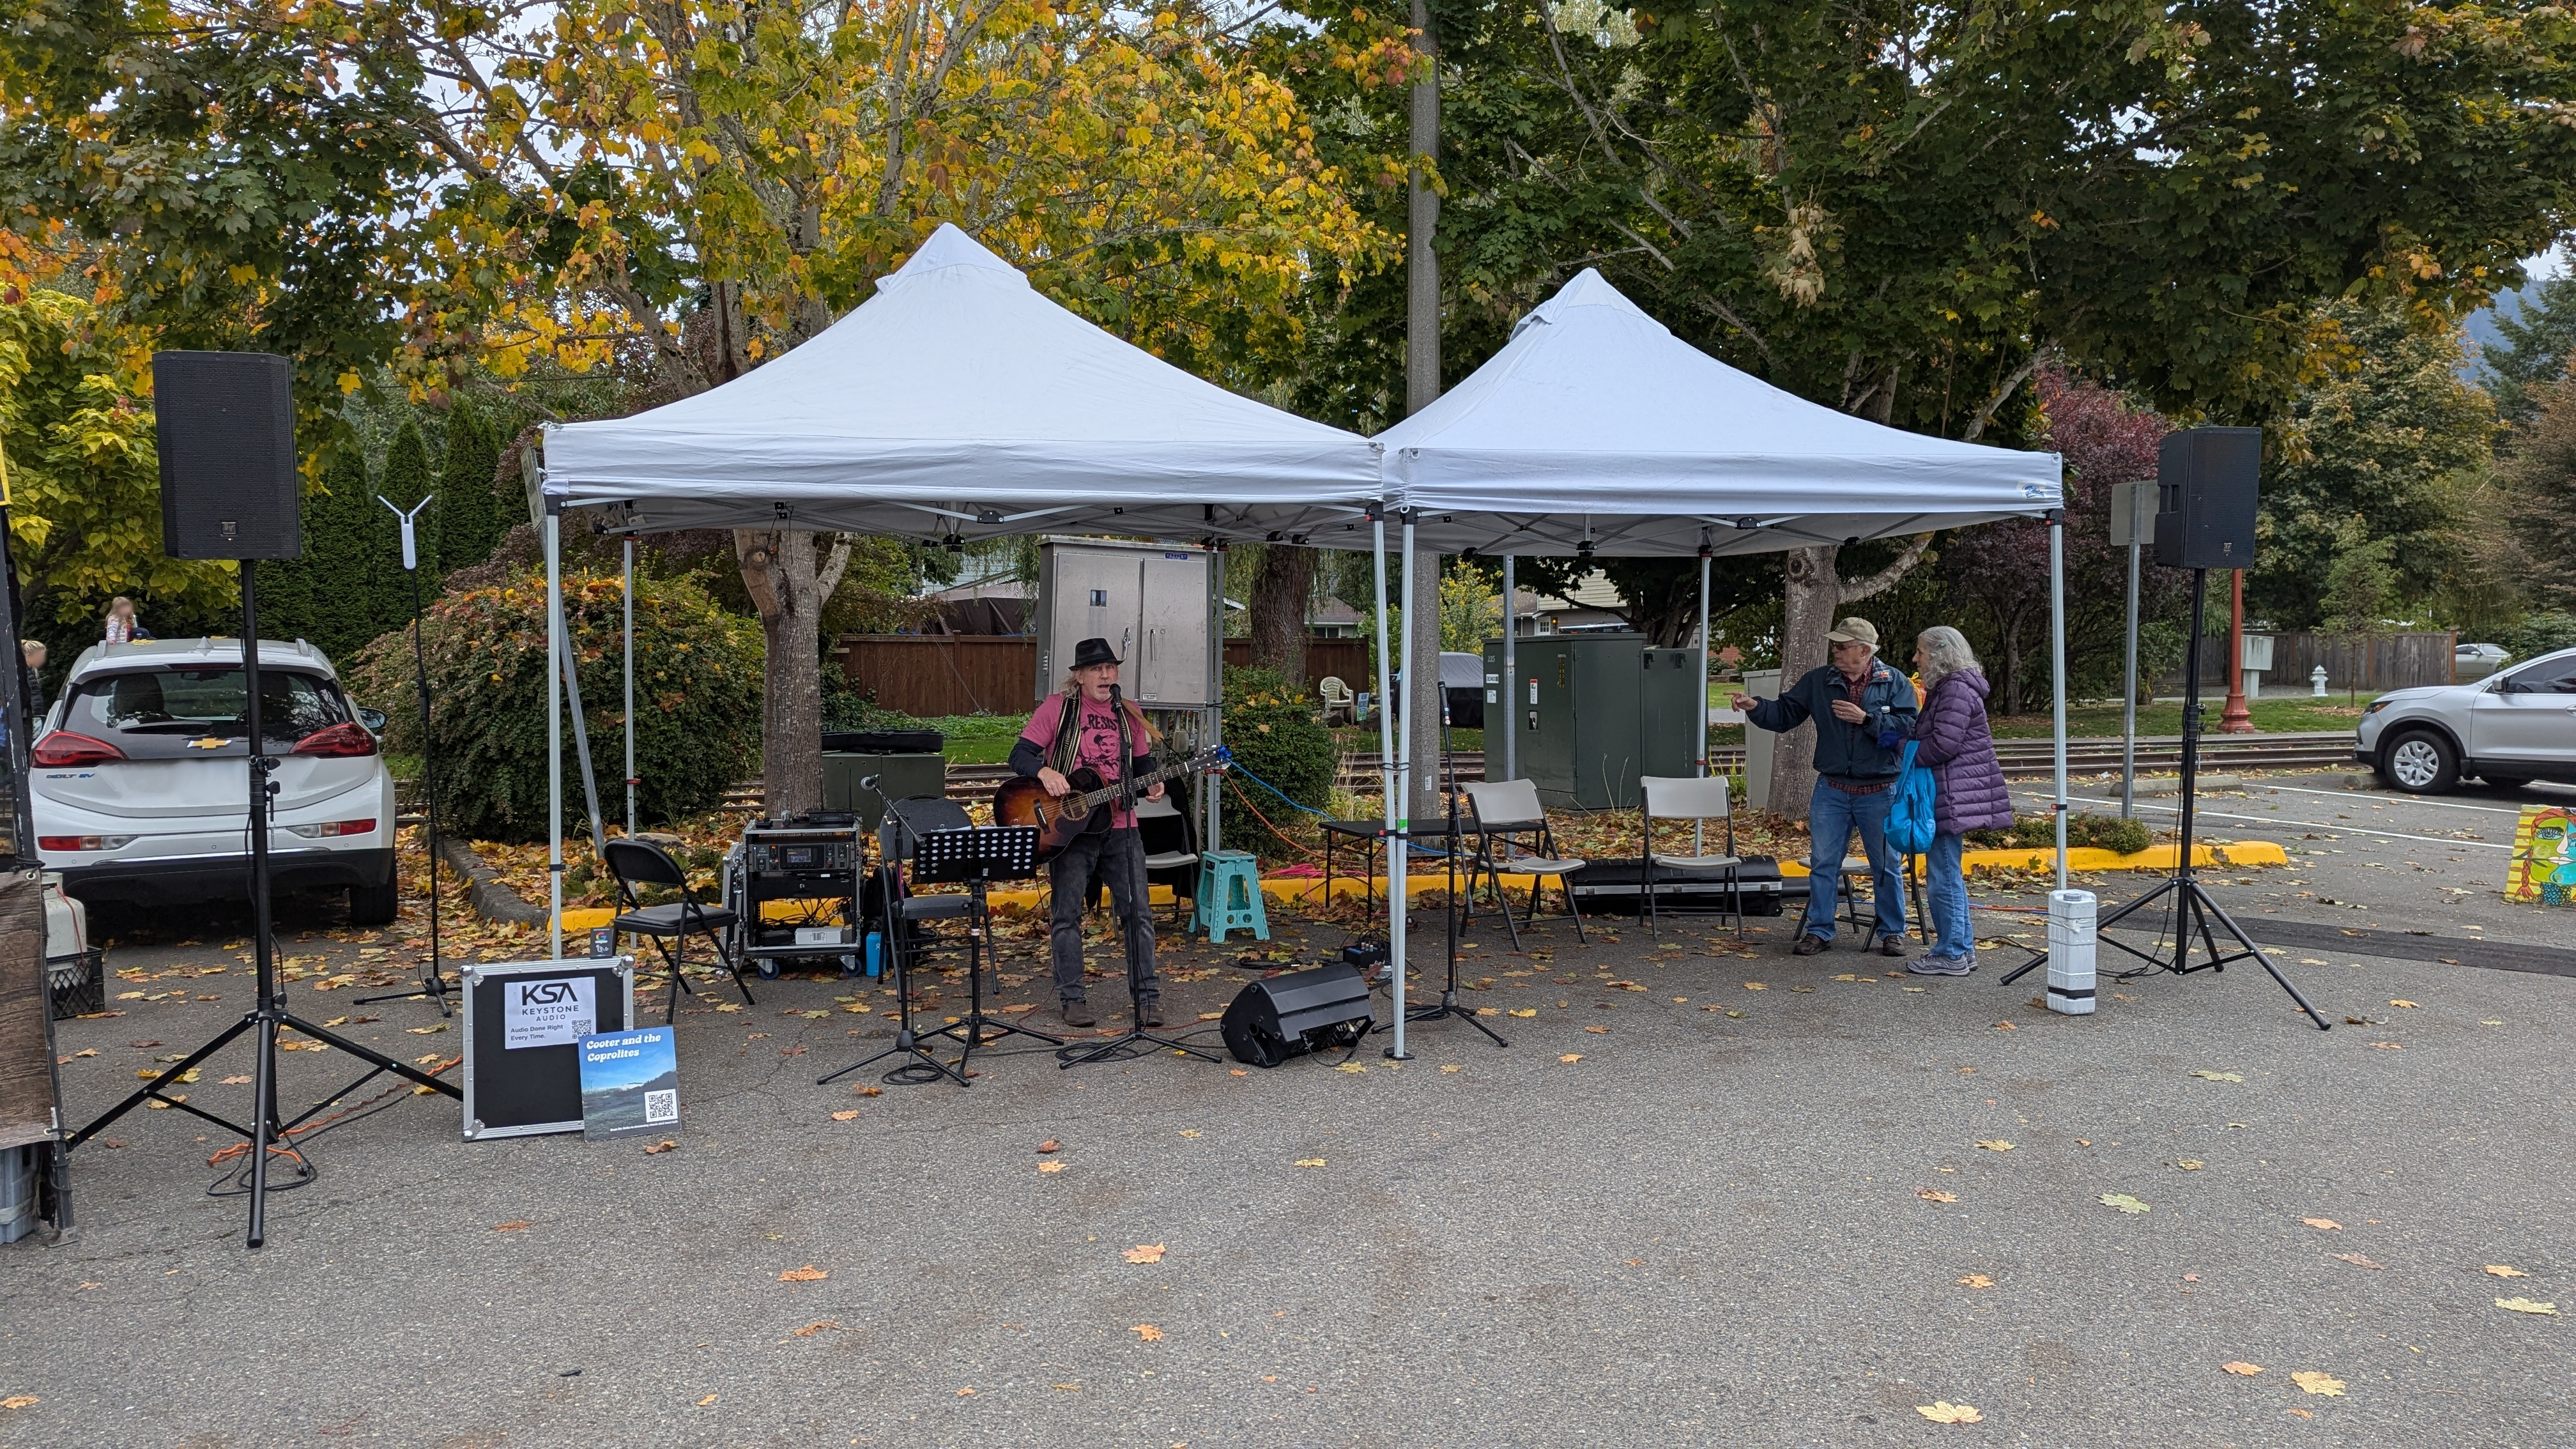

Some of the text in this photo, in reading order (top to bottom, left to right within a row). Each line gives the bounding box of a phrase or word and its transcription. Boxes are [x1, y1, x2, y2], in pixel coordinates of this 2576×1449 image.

[521, 982, 578, 1006] KSA
[522, 1005, 579, 1015] KEYSTONE
[586, 1033, 661, 1050] Cooter and the
[587, 1049, 640, 1062] Coprolites
